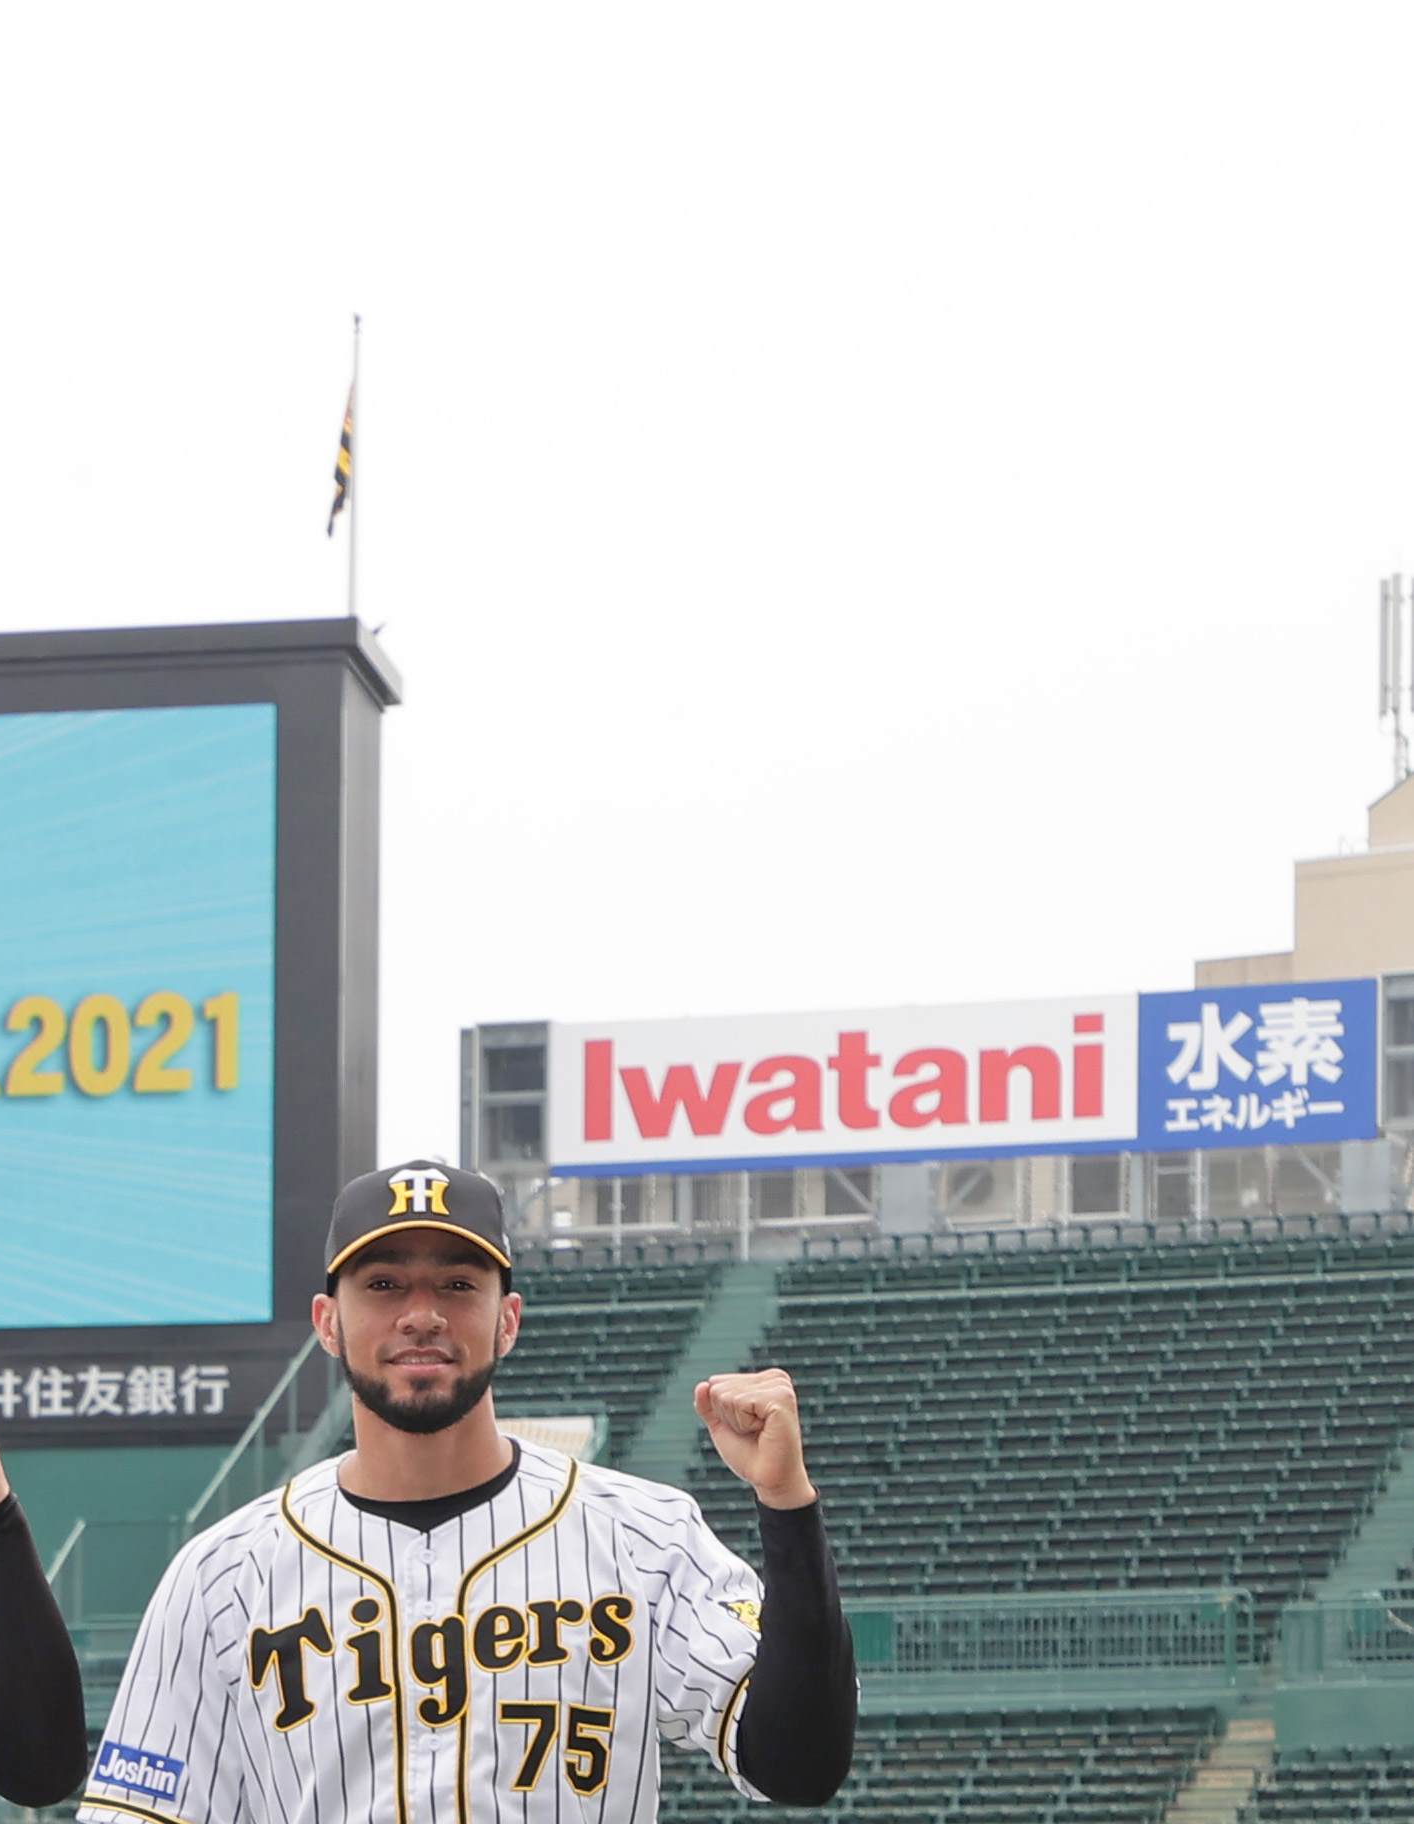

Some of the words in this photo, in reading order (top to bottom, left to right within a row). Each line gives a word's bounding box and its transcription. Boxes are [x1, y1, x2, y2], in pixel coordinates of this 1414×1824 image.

[583, 1013, 1105, 1143] Iwatani
[1166, 997, 1345, 1090] 水素
[1165, 1087, 1345, 1132] エネルギー
[248, 1594, 635, 1733] Tigers
[98, 1748, 177, 1794] Joshin
[498, 1699, 616, 1798] 75
